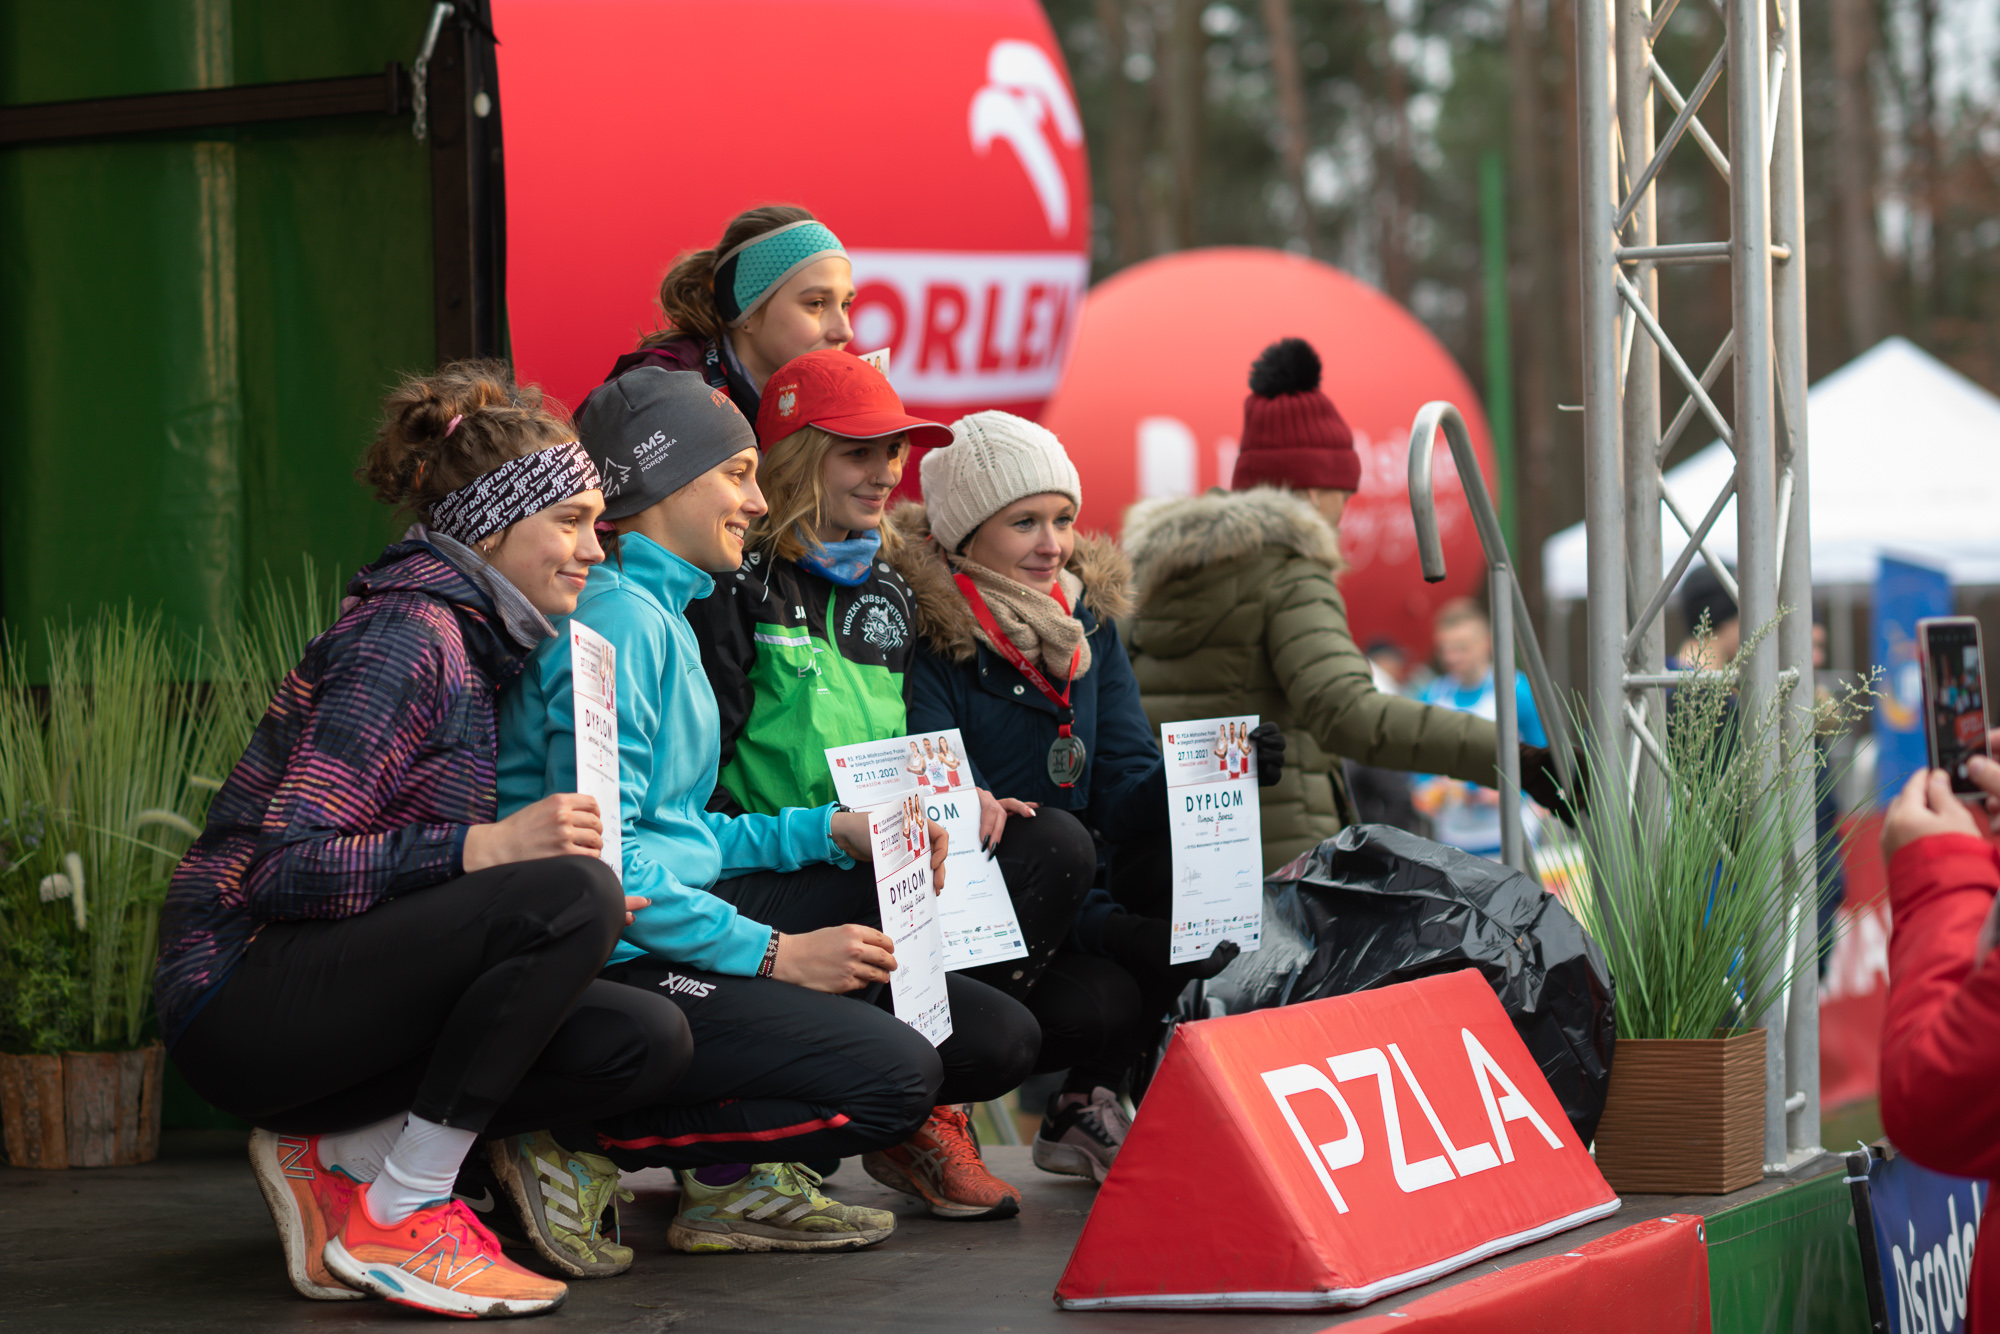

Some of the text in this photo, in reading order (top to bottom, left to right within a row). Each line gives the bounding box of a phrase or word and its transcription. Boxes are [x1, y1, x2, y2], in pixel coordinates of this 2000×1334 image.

[779, 384, 797, 392] POLSKA
[633, 430, 666, 459] SMS
[638, 438, 677, 466] SZKLARSKA
[843, 601, 862, 635] RUDZKI
[1019, 660, 1050, 692] PZLA
[585, 709, 612, 741] DYPLOM
[1178, 749, 1209, 761] 27.11.2021
[853, 767, 899, 783] 27.11.2021
[1186, 790, 1243, 812] DYPLOM
[890, 868, 926, 905] DYPLOM
[1260, 1027, 1565, 1214] PZLA
